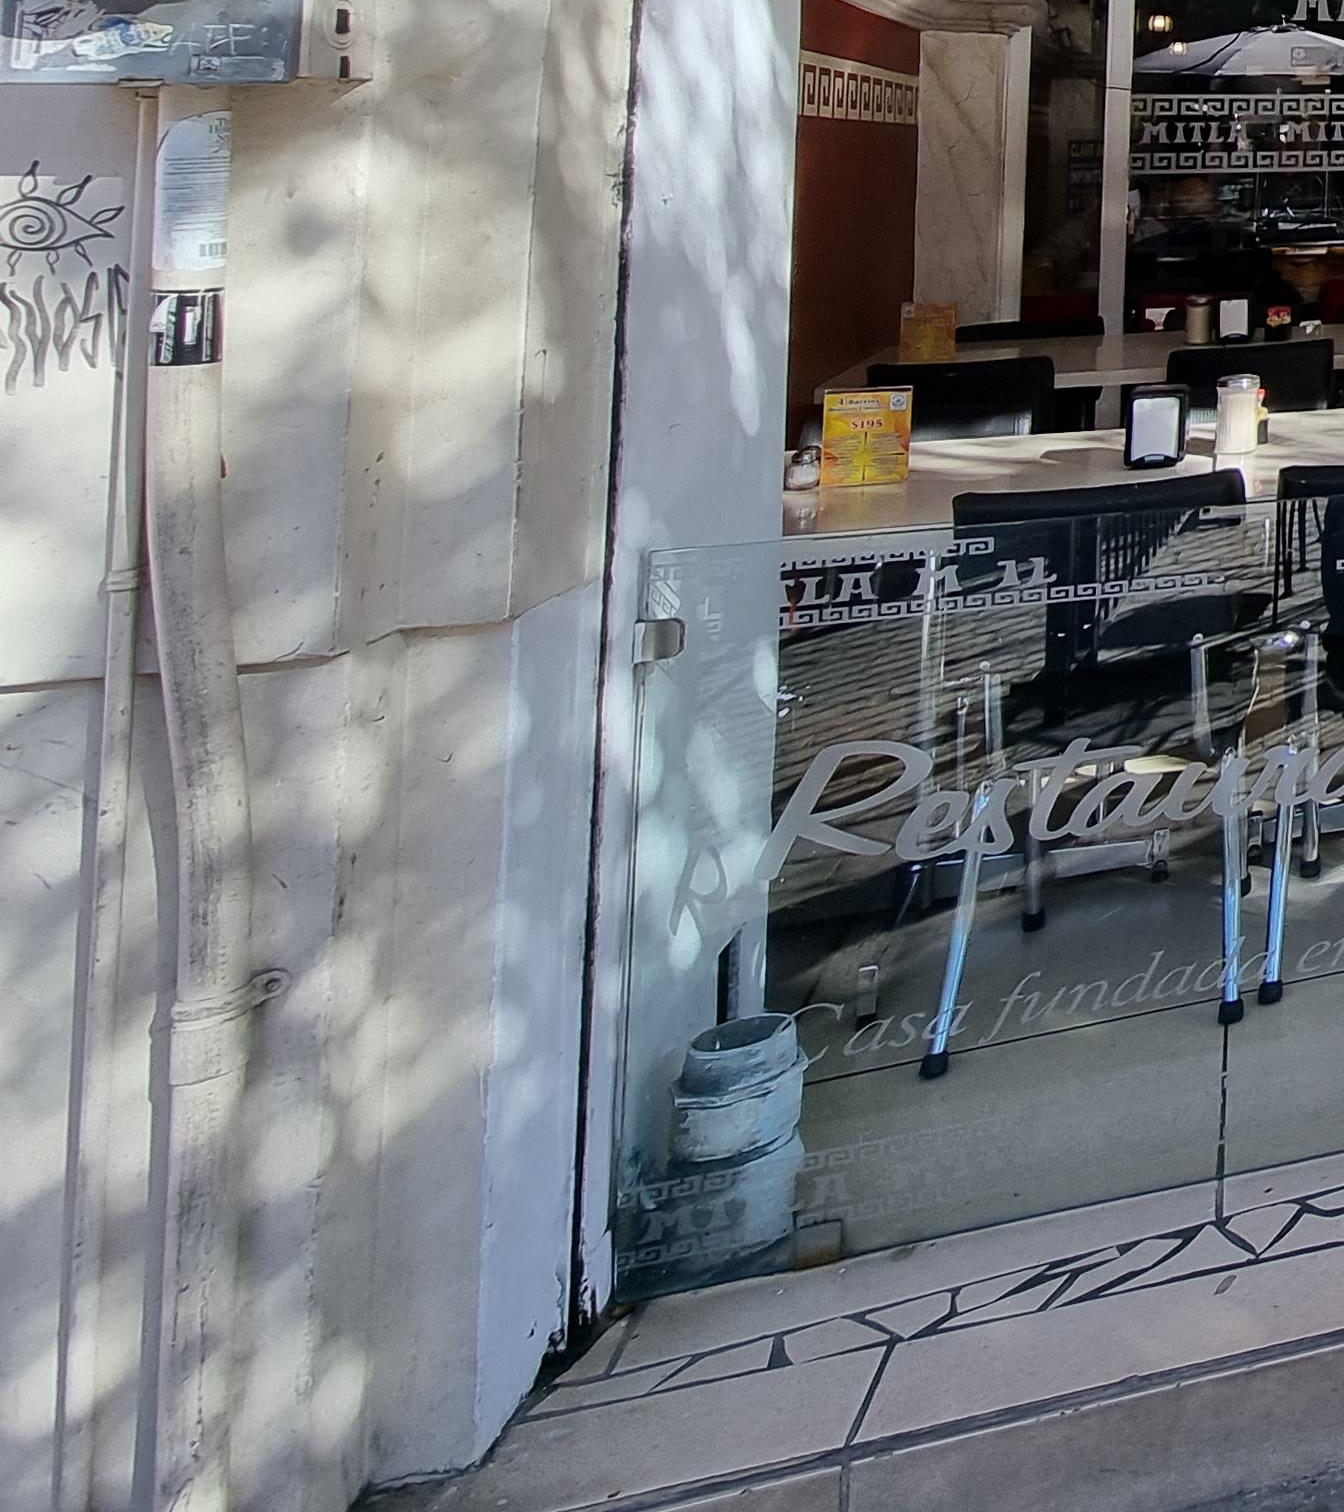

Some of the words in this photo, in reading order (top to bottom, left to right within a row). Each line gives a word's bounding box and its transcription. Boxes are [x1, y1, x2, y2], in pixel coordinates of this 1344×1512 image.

[1138, 121, 1248, 144] MITLA
[851, 418, 883, 430] $195
[772, 1000, 969, 1066] Casa
[975, 932, 1286, 1044] fundada
